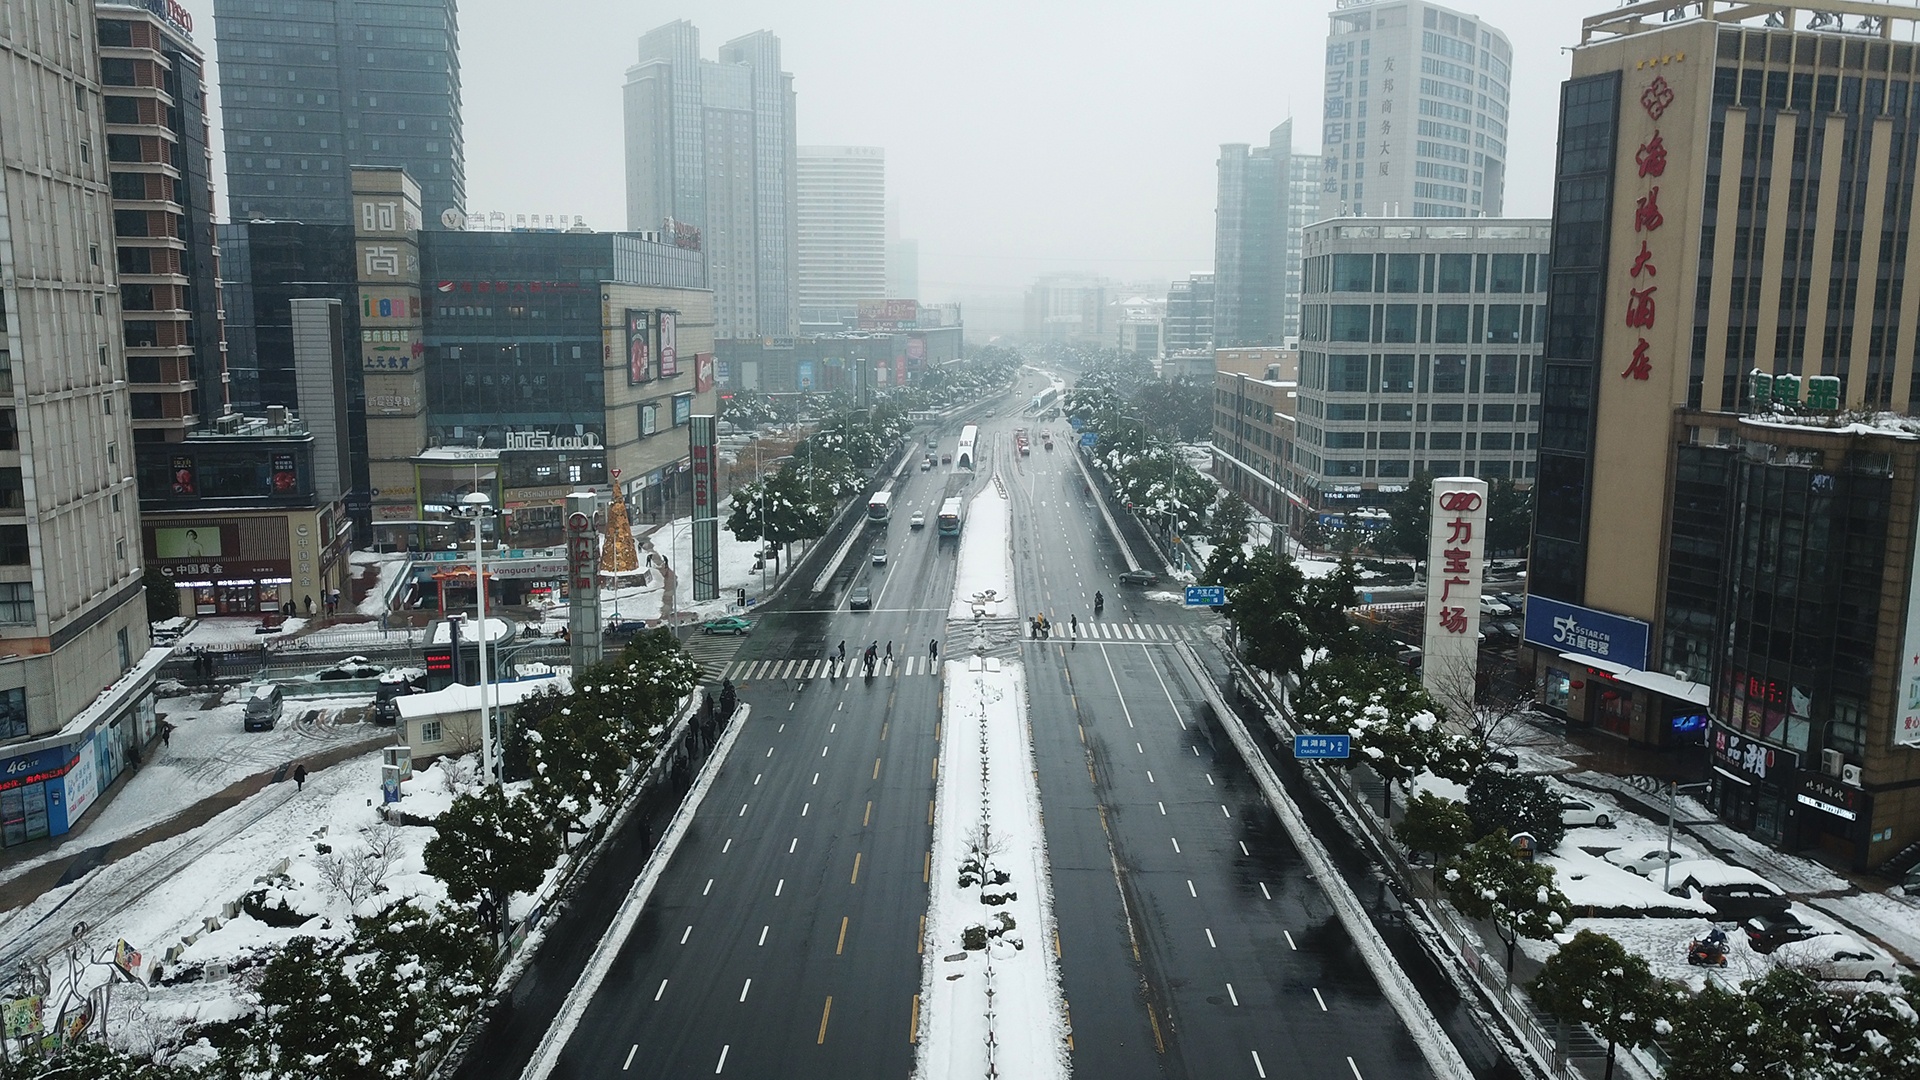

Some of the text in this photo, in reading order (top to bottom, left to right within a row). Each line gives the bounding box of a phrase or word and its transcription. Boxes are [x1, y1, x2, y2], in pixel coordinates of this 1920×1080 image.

[1379, 57, 1395, 177] 友邦商务大厦
[364, 355, 410, 369] 上元教育
[533, 375, 546, 385] 4F
[176, 563, 223, 575] 中国黄金
[298, 537, 311, 587] 中国黄金
[493, 565, 536, 576] Vanguard
[1439, 517, 1471, 634] 力宝广场
[1565, 632, 1609, 656] 五星电器
[7, 760, 27, 774] 4G
